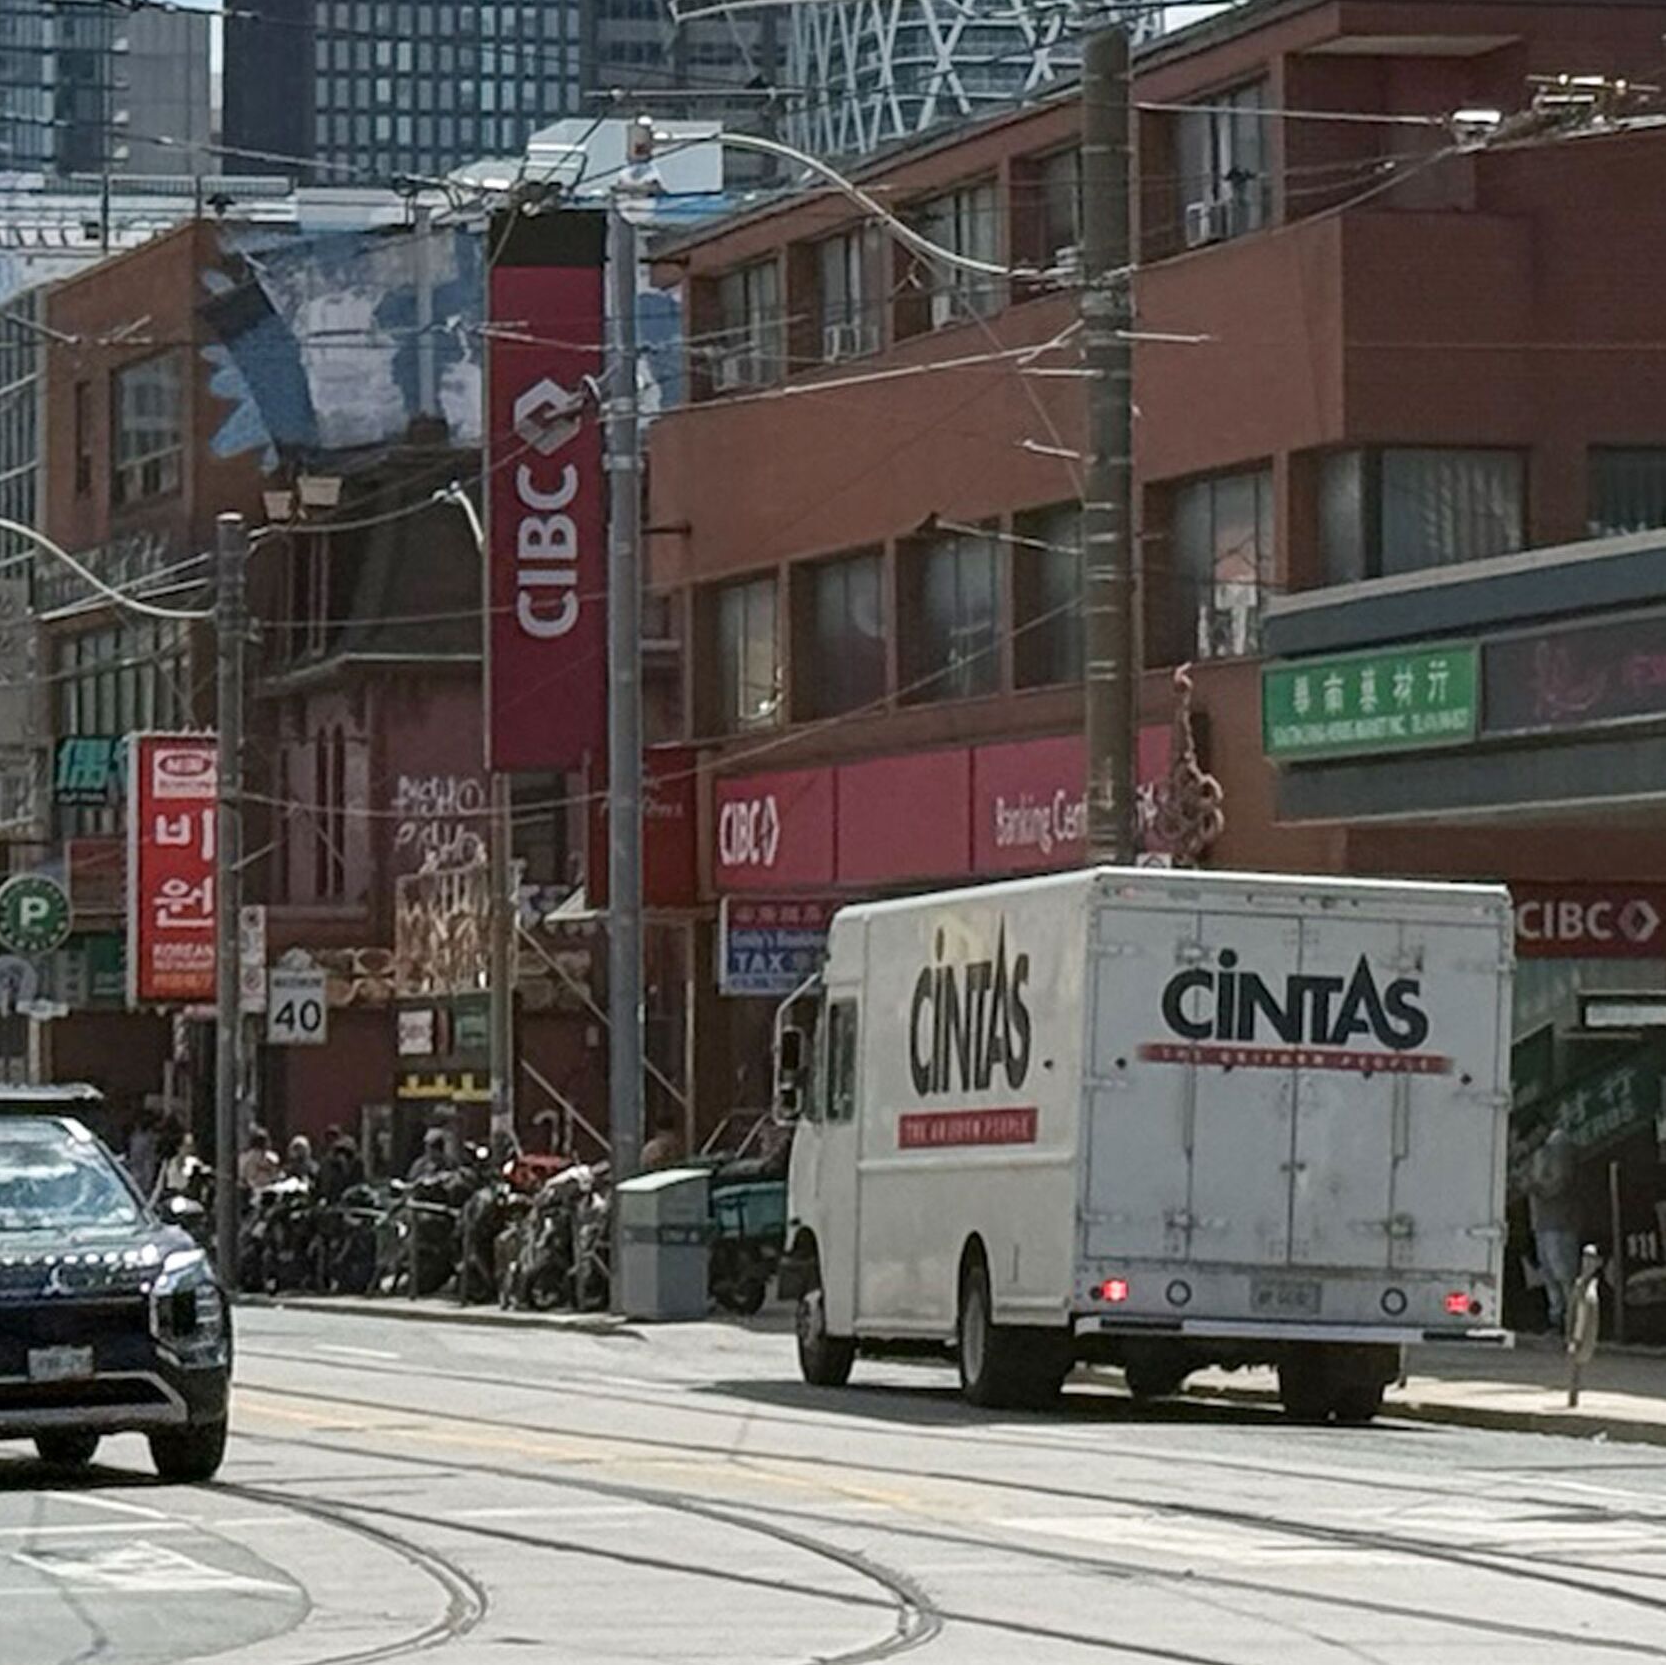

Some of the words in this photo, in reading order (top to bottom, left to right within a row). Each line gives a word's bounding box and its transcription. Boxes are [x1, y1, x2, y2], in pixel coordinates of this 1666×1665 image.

[516, 462, 579, 638] CIBC
[718, 799, 762, 867] CIBC
[995, 793, 1051, 855] Banking
[152, 808, 214, 928] 비원
[1515, 901, 1613, 940] CIBC
[733, 951, 786, 974] TAX
[274, 999, 322, 1033] 40
